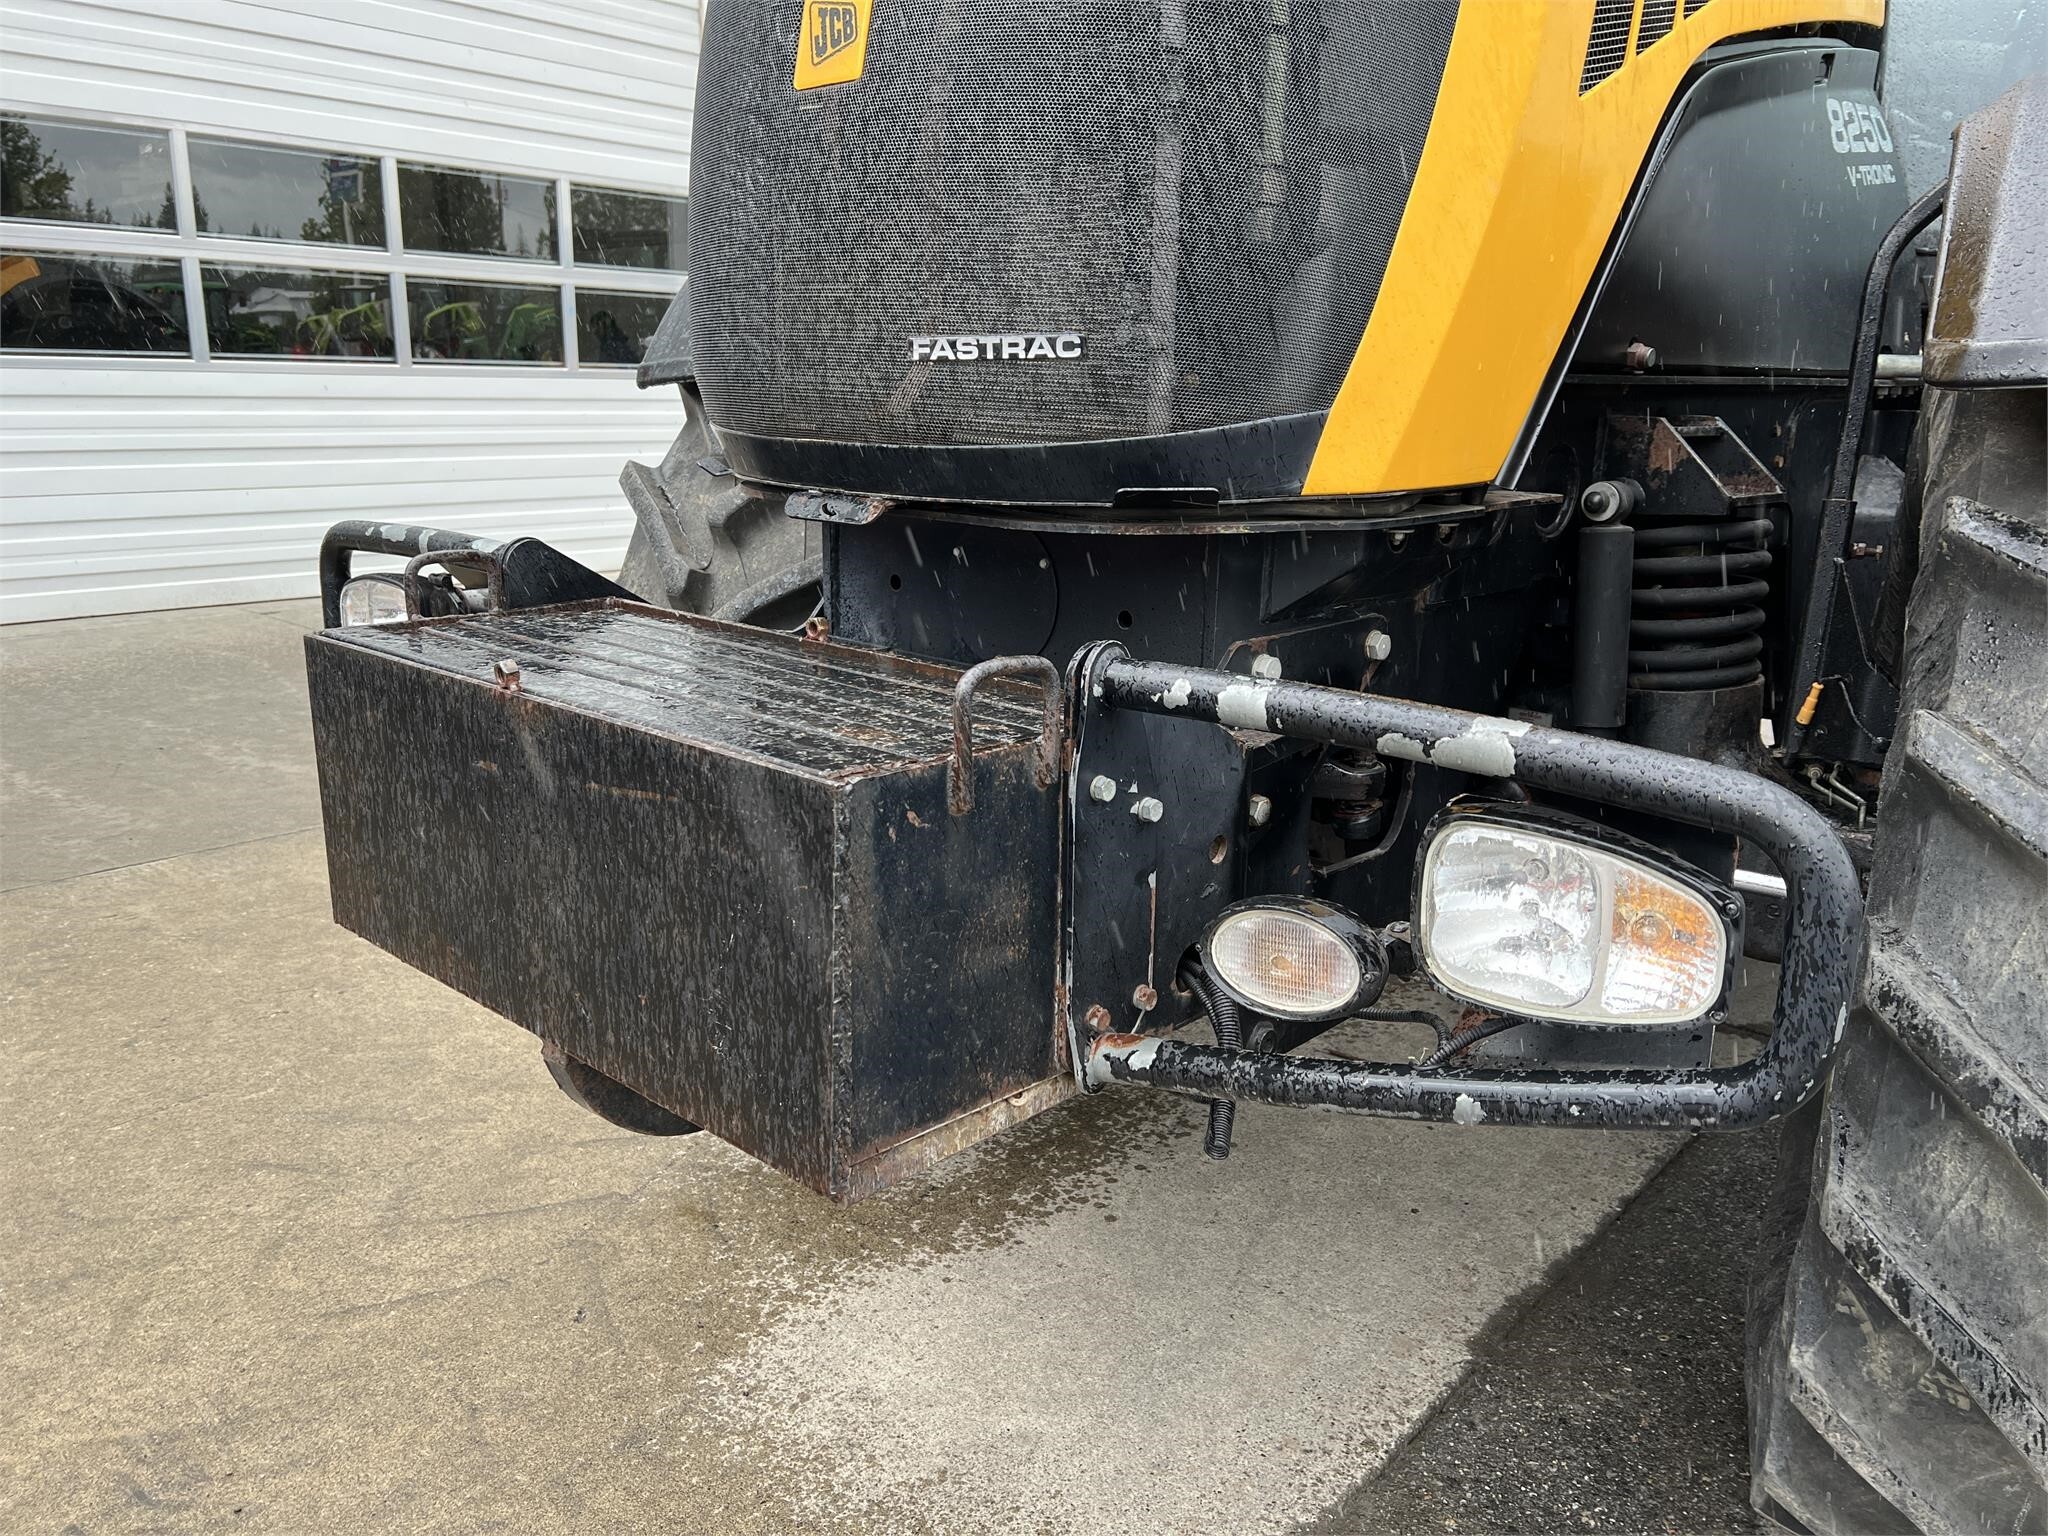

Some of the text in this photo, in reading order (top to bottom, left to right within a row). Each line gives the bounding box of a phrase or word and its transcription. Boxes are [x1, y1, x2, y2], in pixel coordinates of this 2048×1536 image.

[814, 7, 854, 58] JCB
[1826, 98, 1894, 154] 8250
[911, 335, 1082, 361] FASTRAC
